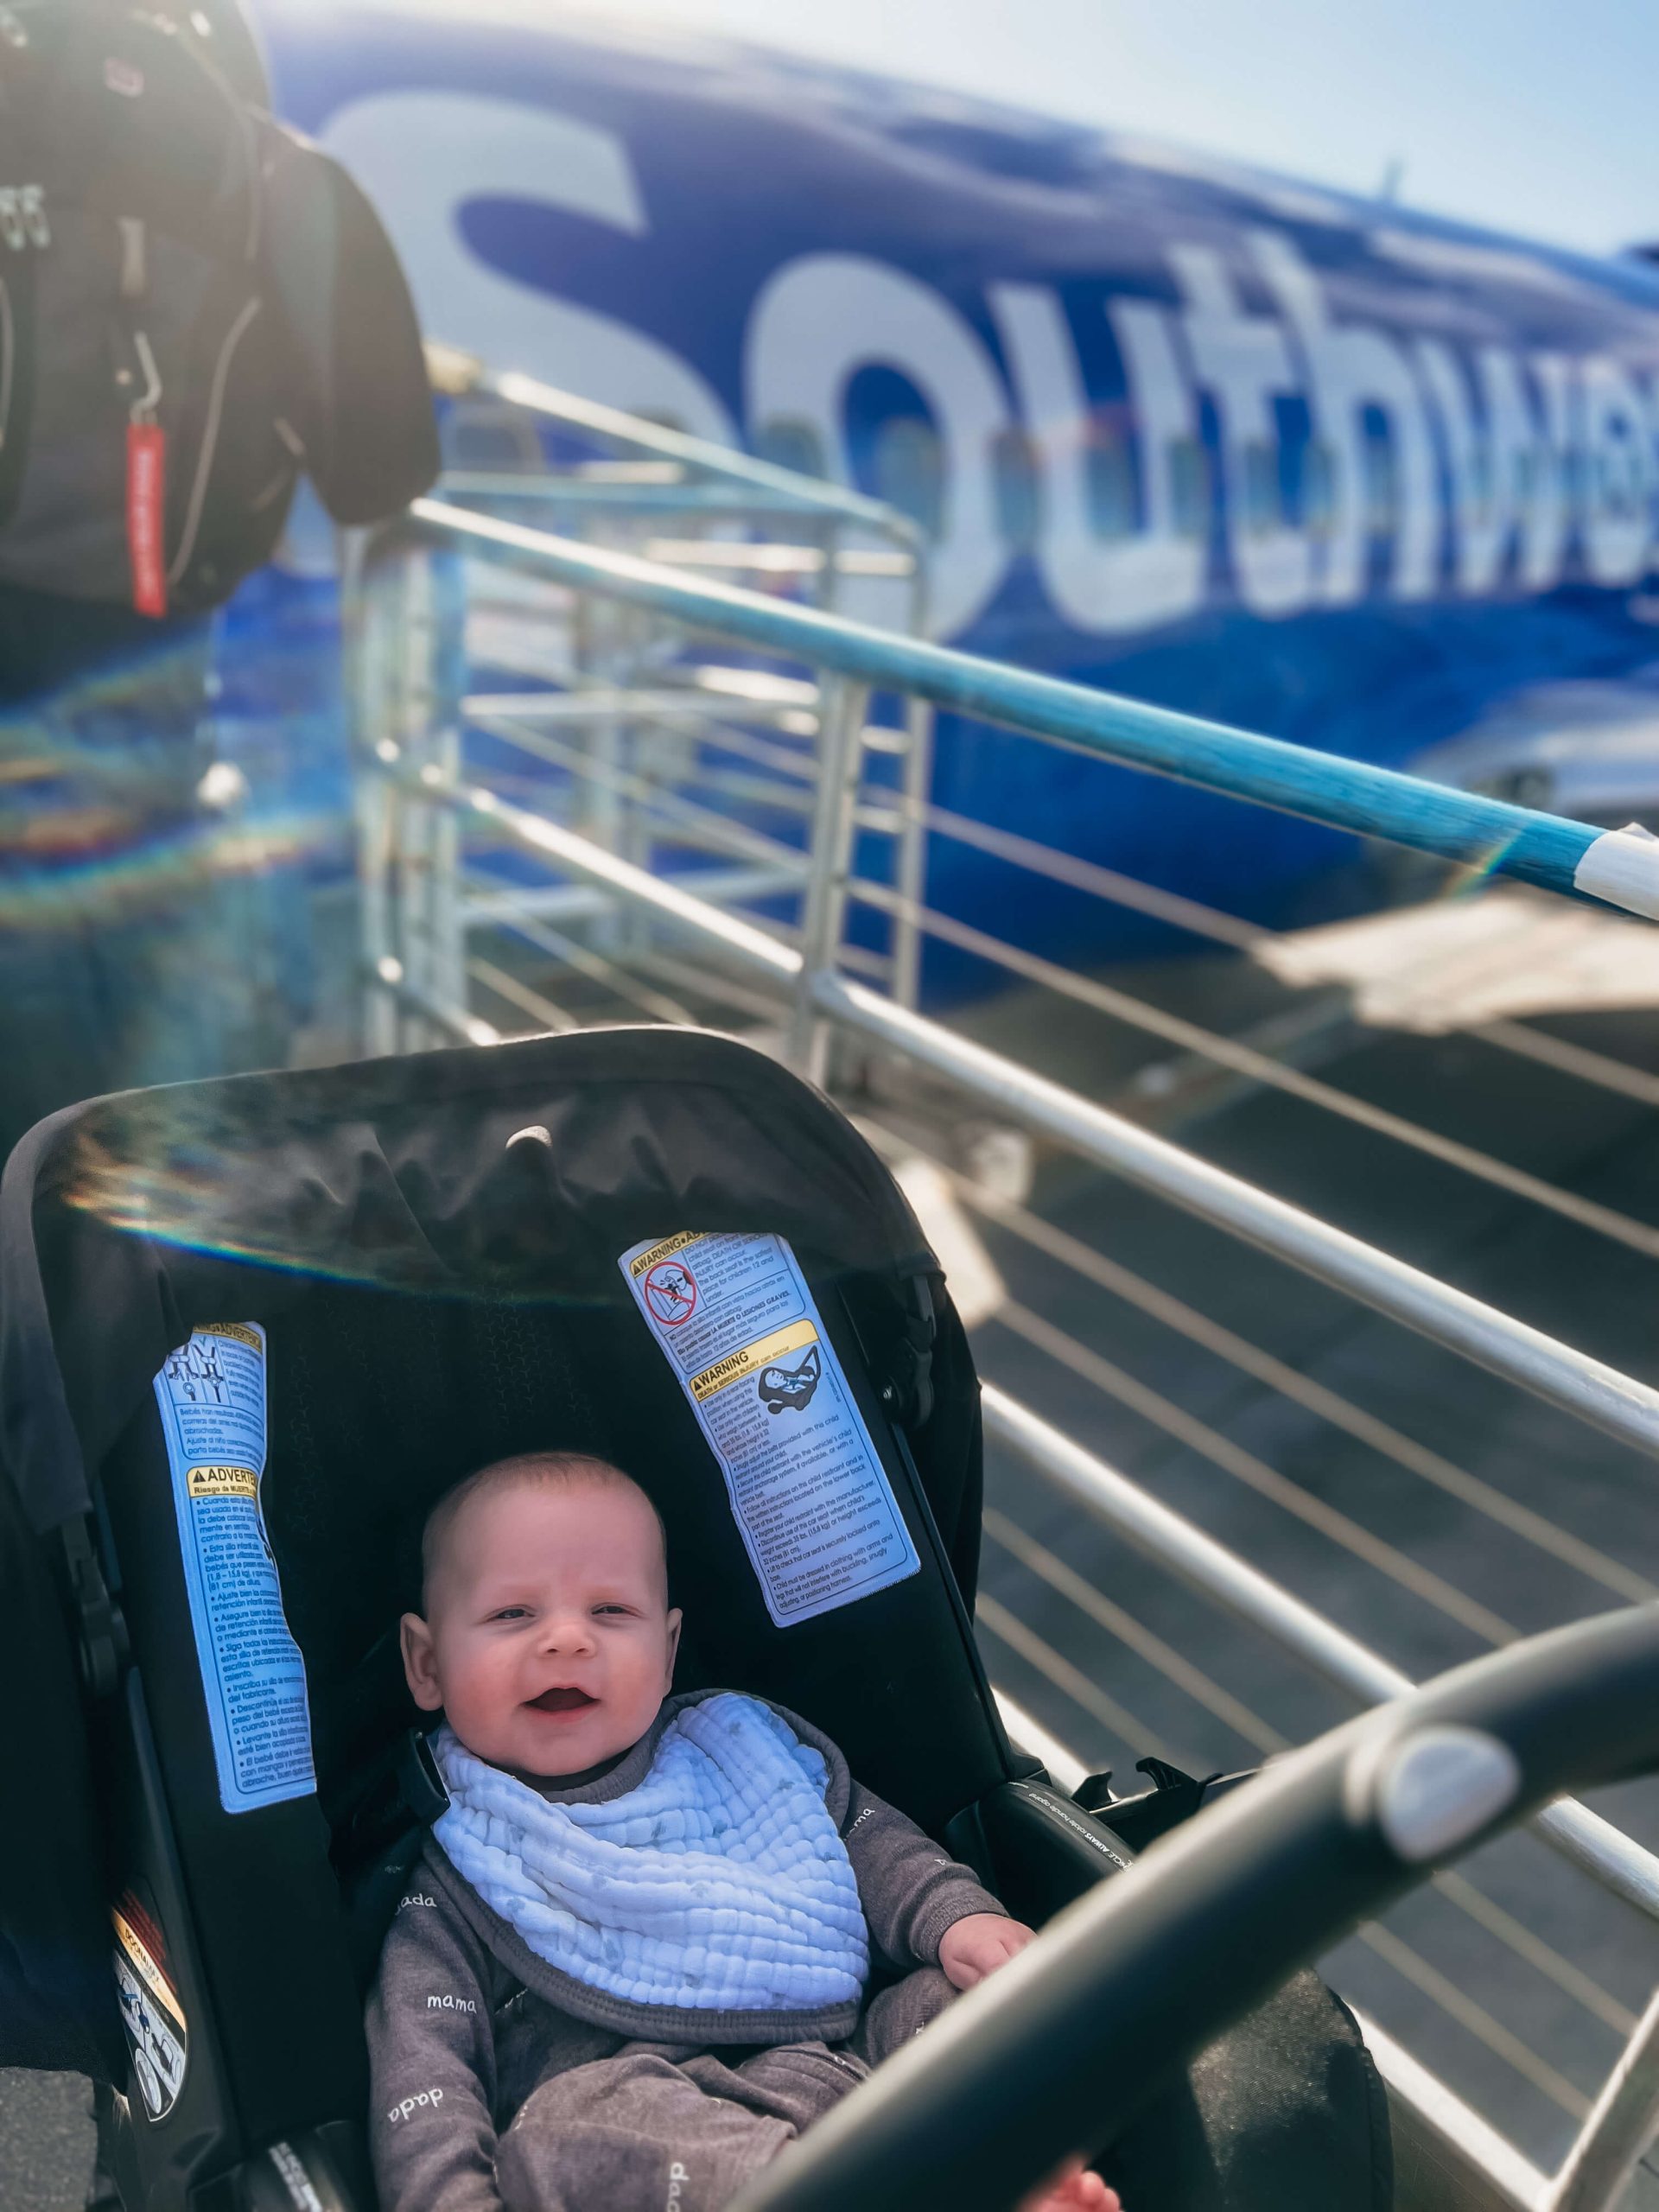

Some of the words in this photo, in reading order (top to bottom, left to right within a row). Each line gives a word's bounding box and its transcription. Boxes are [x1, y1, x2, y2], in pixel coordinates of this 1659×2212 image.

[637, 1236, 682, 1269] WARNING
[696, 1385, 713, 1398] DEATH
[717, 1370, 740, 1387] SERIOUS
[739, 1359, 760, 1375] INJURY
[760, 1354, 772, 1363] can
[772, 1345, 790, 1357] occur
[697, 1350, 749, 1387] WARNING
[1084, 1831, 1109, 1854] ALWAYS
[395, 1893, 437, 1916] ada
[427, 1994, 478, 2015] mama
[386, 2088, 444, 2123] dada
